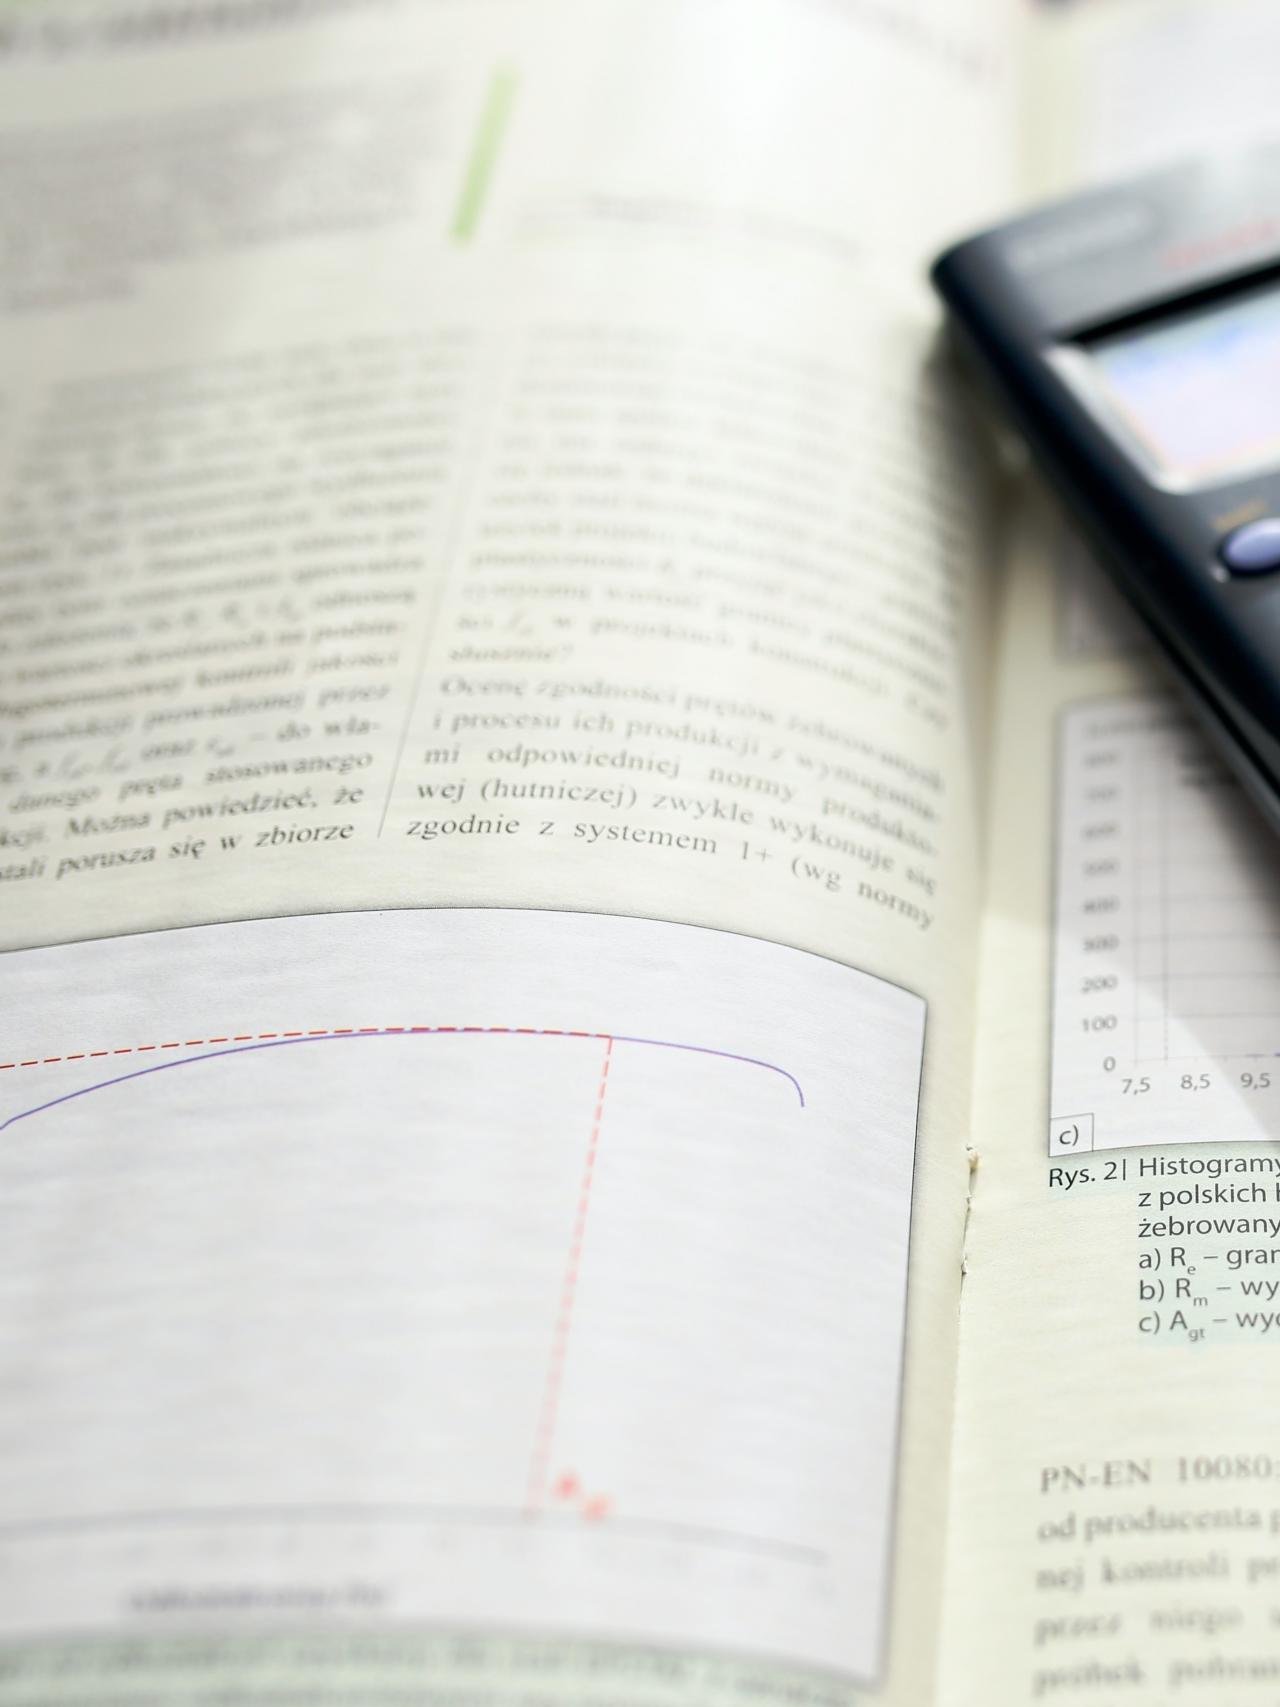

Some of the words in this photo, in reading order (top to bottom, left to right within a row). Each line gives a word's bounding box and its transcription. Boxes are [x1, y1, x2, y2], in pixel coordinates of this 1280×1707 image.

[452, 711, 561, 735] procesu
[573, 710, 615, 732] ich
[424, 743, 461, 765] mi
[487, 743, 681, 779] odpowiedniej
[709, 766, 795, 803] normy
[162, 790, 318, 830] powiedzieć,
[333, 783, 364, 806] że
[417, 778, 467, 804] wej
[480, 778, 638, 809] (hutniczej)
[652, 790, 755, 826] zwykle
[770, 814, 896, 872] wykonuje
[905, 867, 938, 897] się
[56, 844, 156, 880] porusza
[169, 834, 206, 859] się
[220, 834, 242, 851] w
[256, 823, 355, 848] zbiorze
[406, 813, 521, 841] zgodnie
[539, 819, 556, 836] z
[574, 820, 717, 855] systemem
[740, 840, 773, 862] 1+
[791, 856, 842, 891] (wg
[858, 881, 934, 931] normy
[1080, 974, 1118, 994] 200
[1082, 1014, 1118, 1033] 100
[1103, 1056, 1116, 1072] 0
[1121, 1077, 1151, 1095] 7,5
[1180, 1074, 1211, 1092] 8,5
[1240, 1073, 1270, 1090] 9,5
[1058, 1124, 1080, 1147] c)
[1049, 1167, 1097, 1190] Rys.
[1138, 1192, 1152, 1207] z
[1159, 1182, 1268, 1210] polskich
[1138, 1248, 1162, 1271] a)
[1139, 1279, 1165, 1302] b)
[1138, 1311, 1160, 1334] c)
[1041, 1458, 1152, 1494] PN-EN
